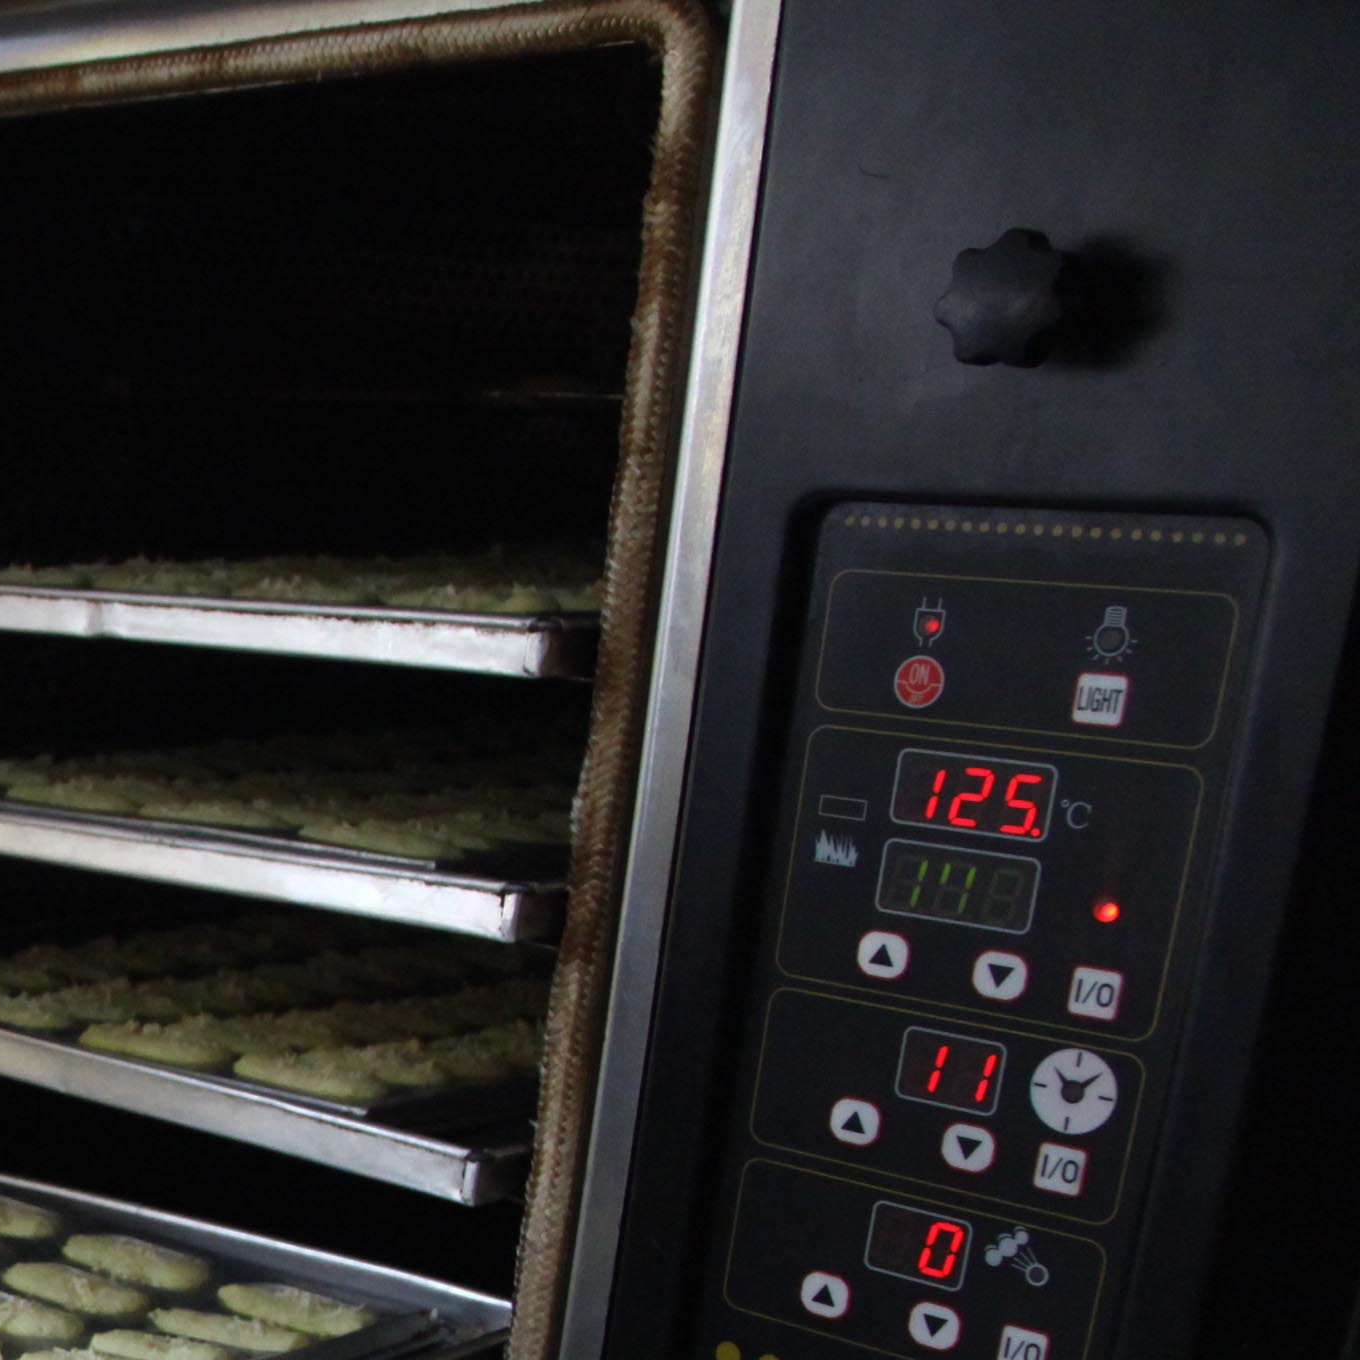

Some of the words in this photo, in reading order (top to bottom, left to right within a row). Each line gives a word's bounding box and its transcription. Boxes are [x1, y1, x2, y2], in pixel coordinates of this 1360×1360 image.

[908, 662, 931, 686] ON
[1077, 686, 1123, 714] LIGHT
[1074, 978, 1115, 1008] I/O
[927, 1045, 998, 1102] 11
[1040, 1153, 1079, 1184] I/O
[917, 1221, 965, 1279] 0
